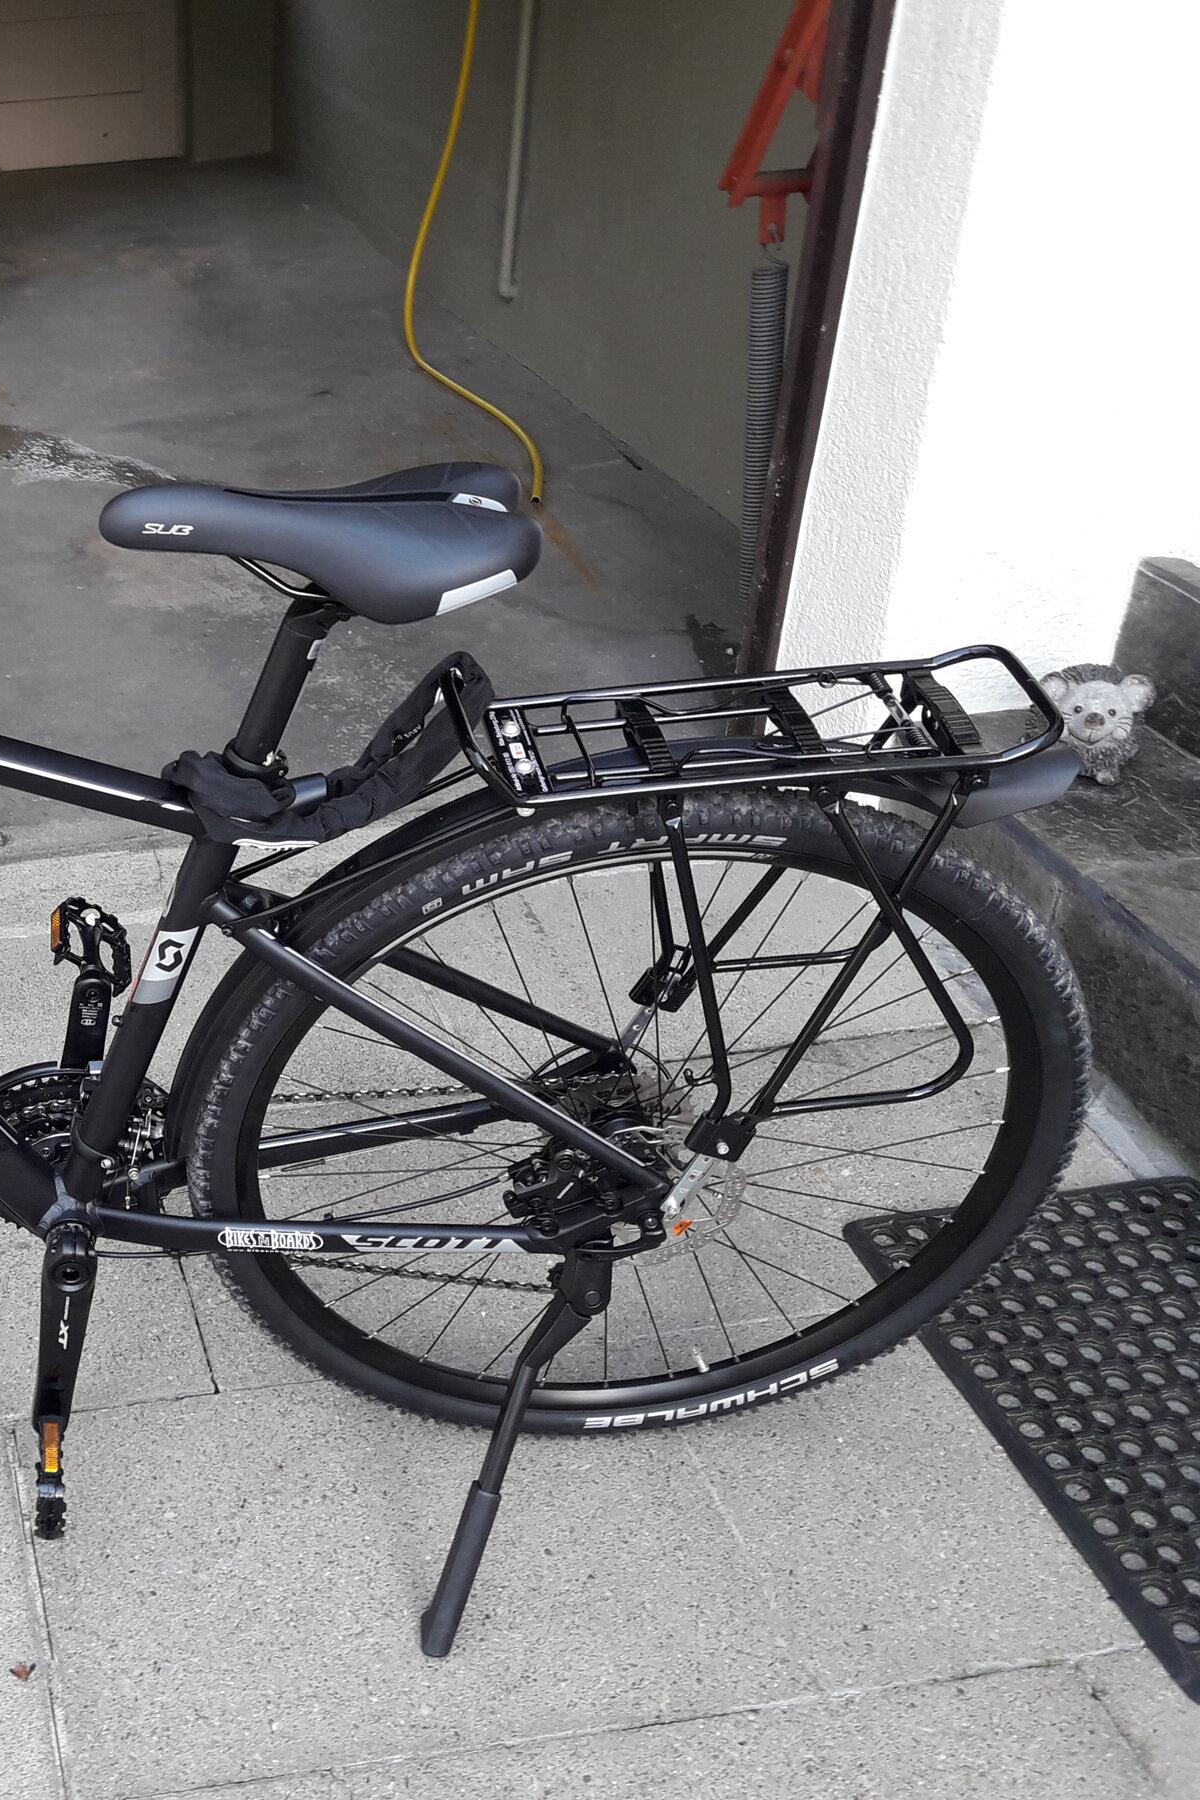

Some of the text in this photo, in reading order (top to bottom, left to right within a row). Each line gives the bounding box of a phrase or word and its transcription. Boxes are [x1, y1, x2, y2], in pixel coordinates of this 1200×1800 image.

[142, 522, 195, 536] SUB
[462, 850, 574, 896] SAM
[224, 1227, 257, 1248] BIKES
[270, 1229, 317, 1251] BOARDS
[354, 1235, 499, 1249] SCOTT
[58, 1319, 70, 1351] XT
[583, 1358, 839, 1429] SCHWALBE
